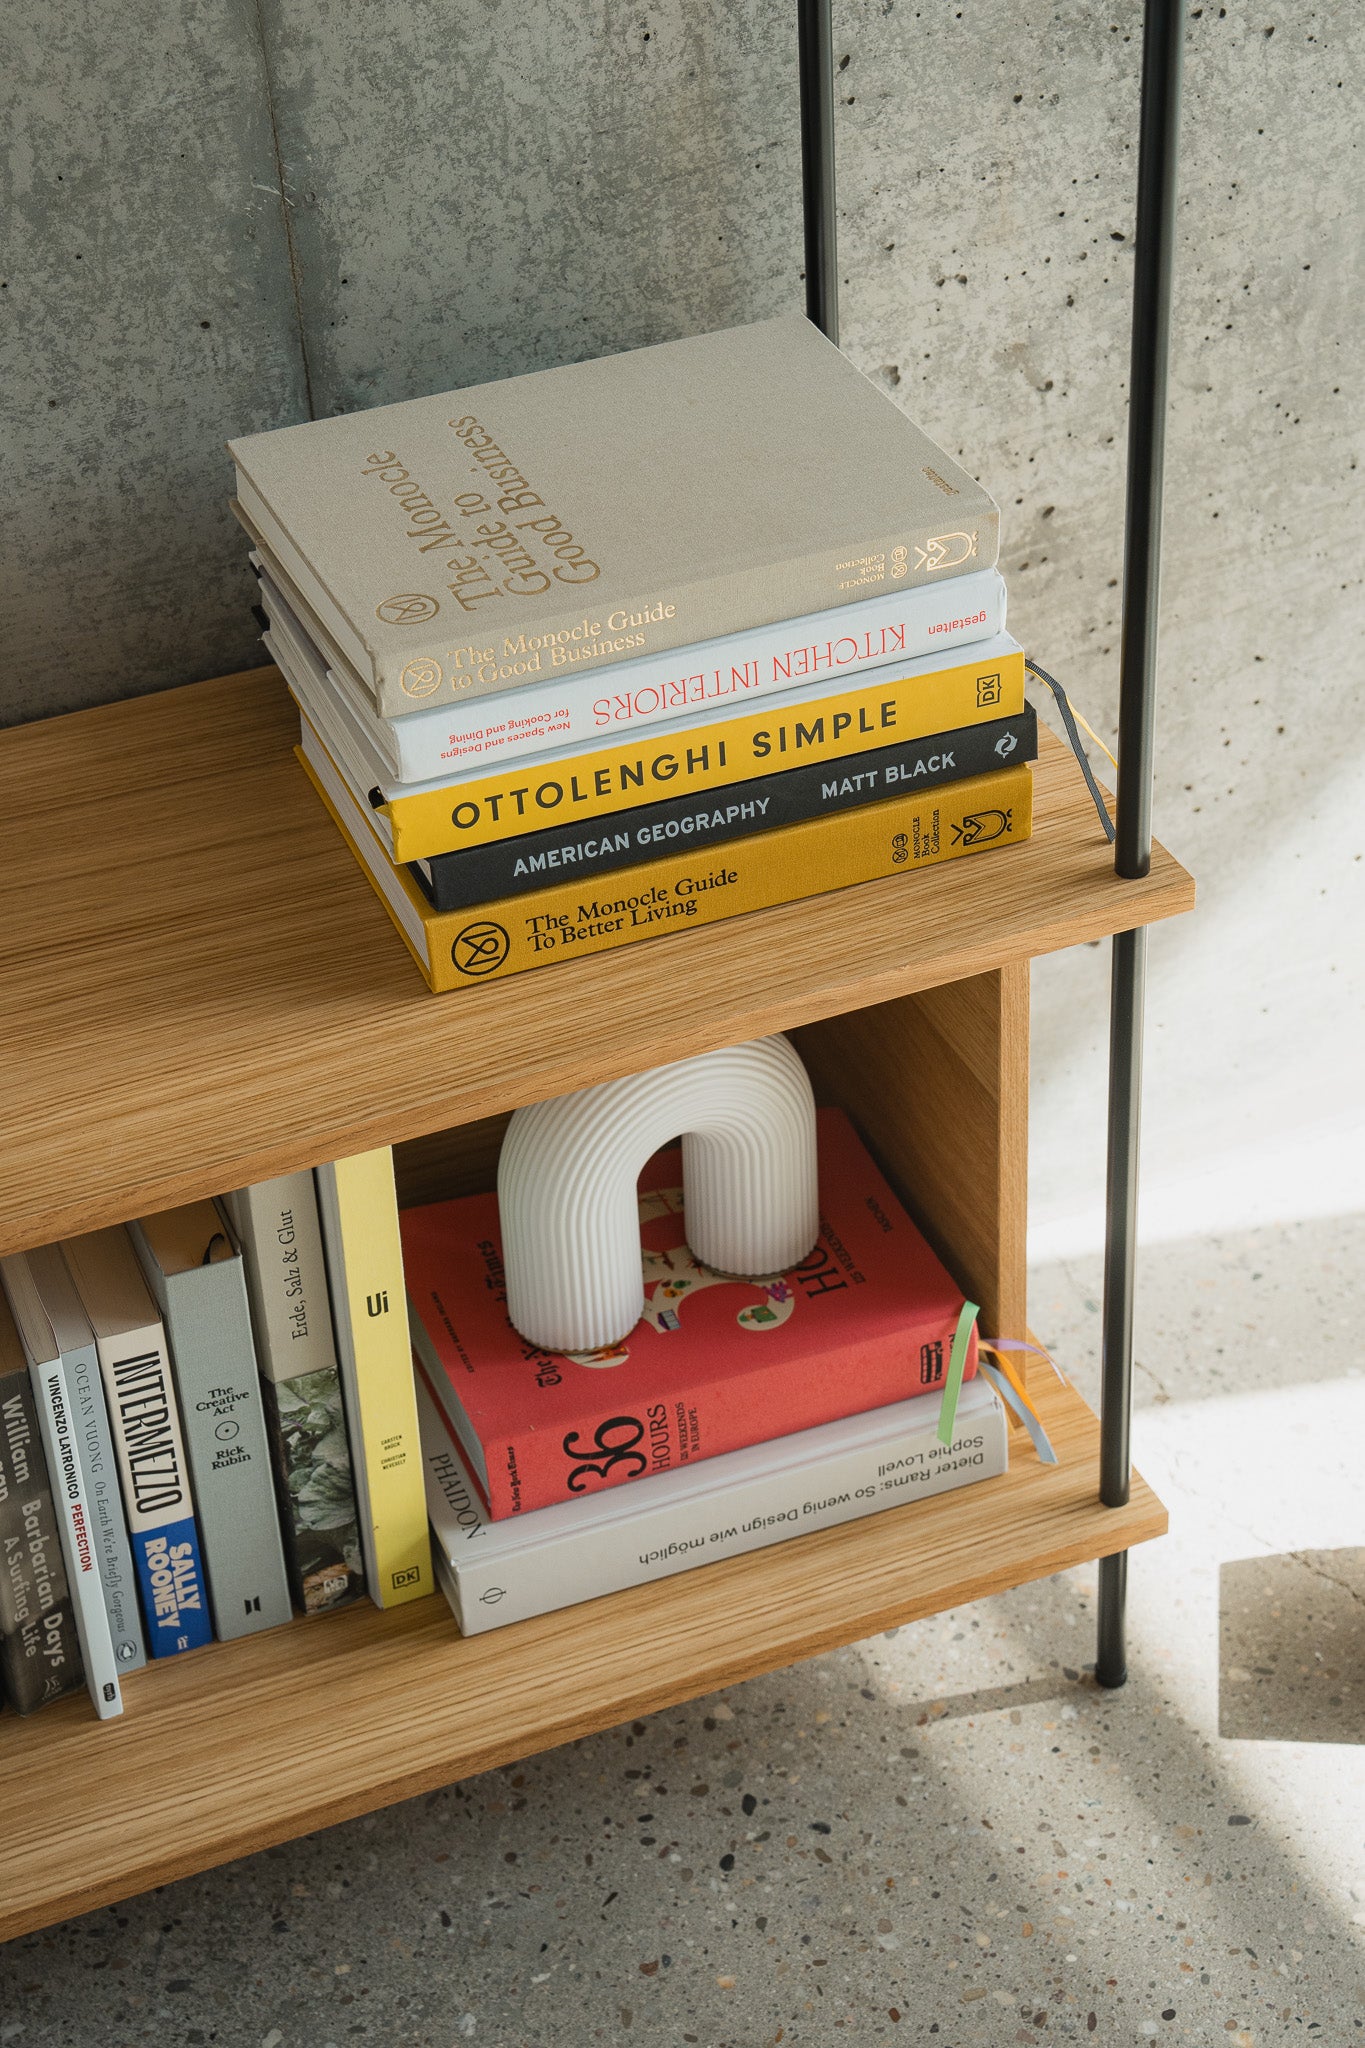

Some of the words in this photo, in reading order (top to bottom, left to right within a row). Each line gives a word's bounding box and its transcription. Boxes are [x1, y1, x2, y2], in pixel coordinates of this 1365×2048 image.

[448, 415, 546, 515] Business
[361, 450, 465, 553] Monocle
[454, 493, 492, 517] to
[470, 521, 551, 596] Guide
[515, 515, 600, 584] Good
[836, 553, 885, 570] Collection
[446, 555, 504, 611] The
[840, 573, 885, 590] MONOCLE
[860, 563, 885, 576] Book
[448, 647, 495, 670] The
[503, 622, 601, 657] Monocle
[607, 602, 676, 631] Guide
[928, 611, 987, 634] gestalten
[450, 674, 472, 691] to
[477, 652, 542, 683] Good
[551, 632, 646, 666] Business
[772, 623, 906, 682] KITCHEN
[592, 660, 759, 726] INTERIORS
[507, 713, 552, 730] Cooking
[547, 721, 571, 733] New
[554, 708, 570, 718] for
[448, 730, 483, 745] Dining
[485, 738, 505, 751] and
[486, 724, 506, 737] and
[507, 727, 545, 743] Spaces
[440, 743, 482, 759] Designs
[451, 741, 727, 829] OTTOLENGHI
[752, 700, 897, 758] SIMPLE
[822, 771, 878, 799] MATT
[885, 751, 956, 783] BLACK
[513, 832, 630, 877] AMERICAN
[636, 797, 770, 845] GEOGRAPHY
[922, 833, 930, 857] Book
[931, 809, 940, 854] Collection
[526, 914, 570, 934] The
[576, 888, 668, 923] Monocle
[674, 869, 738, 896] Guide
[527, 933, 555, 952] To
[561, 917, 624, 945] Better
[631, 899, 698, 926] Living
[277, 1209, 295, 1245] Glut
[282, 1248, 298, 1263] &
[284, 1267, 303, 1297] Salz
[366, 1290, 389, 1318] Ui
[289, 1299, 309, 1341] Erde,
[534, 1361, 563, 1388] The
[74, 1363, 95, 1417] OCEAN
[196, 1391, 250, 1411] Creative
[208, 1387, 234, 1399] The
[213, 1404, 235, 1417] Act
[688, 1407, 699, 1442] EUROPE
[2, 1394, 31, 1484] William
[112, 1350, 183, 1514] INTERMEZZO
[647, 1404, 671, 1471] HOURS
[675, 1402, 688, 1451] WEEKENDS
[83, 1419, 104, 1474] VUONG
[215, 1446, 245, 1460] Rick
[563, 1416, 647, 1493] 36
[928, 1436, 984, 1459] Sophie
[47, 1374, 68, 1435] VINCENZO
[58, 1436, 80, 1500] LATRONICO
[71, 1503, 93, 1572] PERFECTION
[211, 1454, 251, 1471] Rubin
[878, 1453, 924, 1477] Lovell
[935, 1452, 984, 1475] Dieter
[94, 1481, 107, 1497] On
[855, 1485, 876, 1498] So
[880, 1469, 931, 1491] Rams:
[429, 1453, 486, 1540] PHAIDON
[803, 1493, 851, 1515] wenig
[97, 1498, 113, 1527] Earth
[742, 1508, 799, 1532] Design
[4, 1536, 20, 1551] A
[709, 1528, 738, 1543] wie
[639, 1537, 705, 1565] möglich
[8, 1551, 31, 1623] Surfing
[21, 1499, 56, 1610] Barbarian
[43, 1612, 65, 1668] Days
[104, 1556, 122, 1588] Briefly
[144, 1536, 181, 1628] ROONEY
[169, 1542, 201, 1611] SALLY
[110, 1590, 126, 1633] Gorgeous
[21, 1621, 41, 1658] Life
